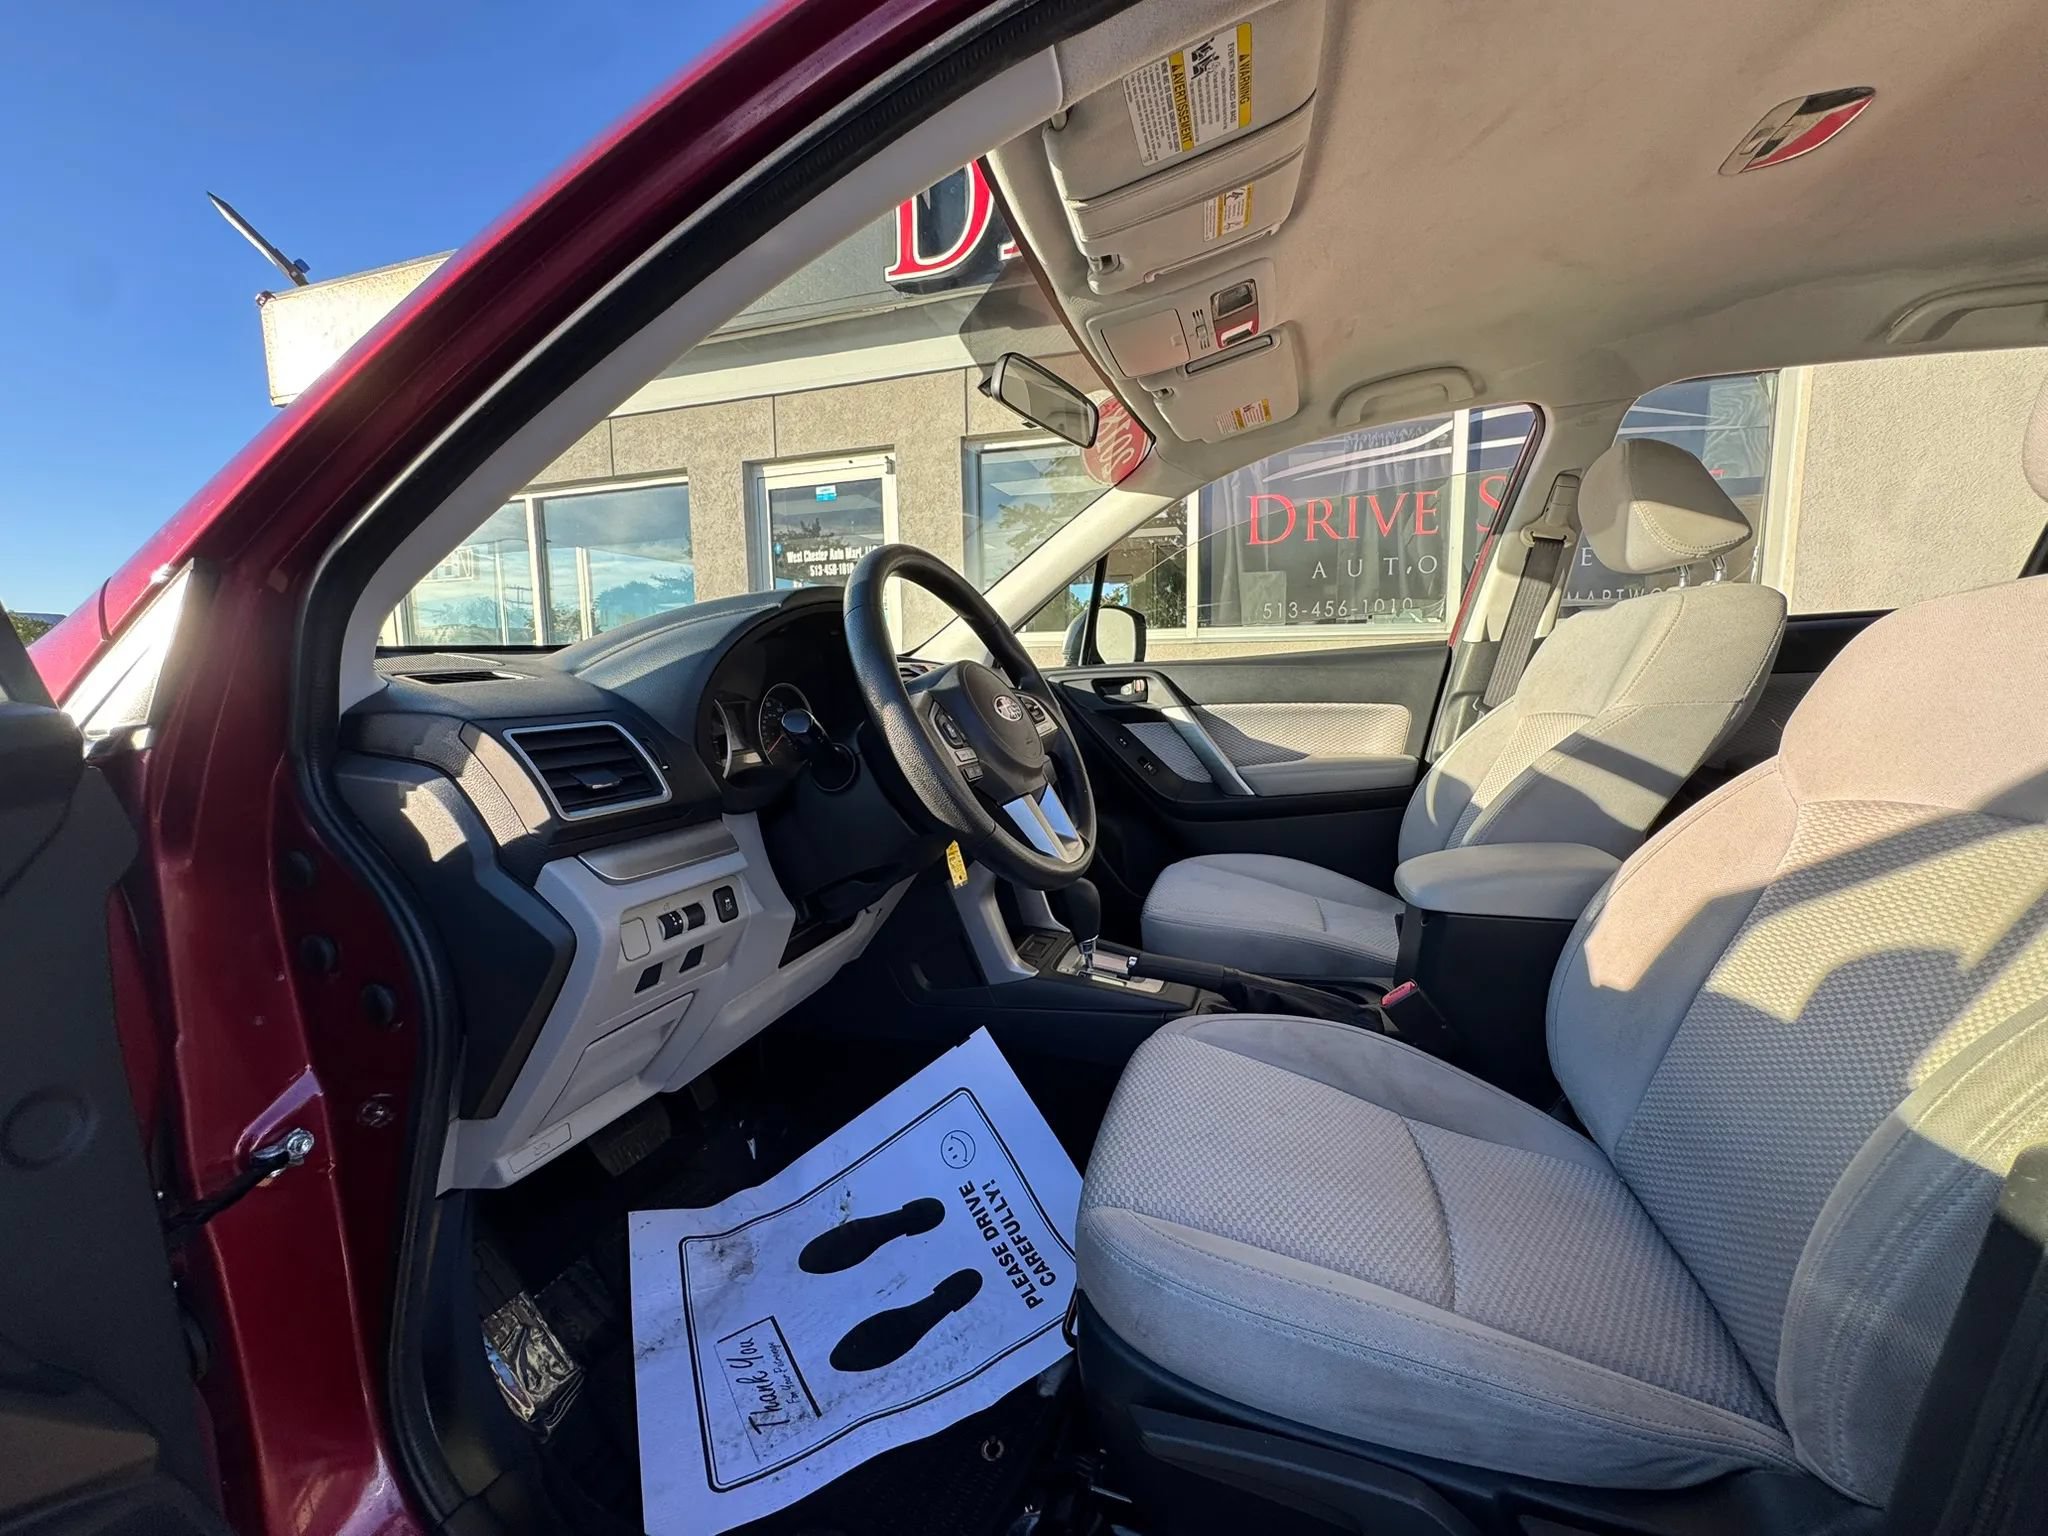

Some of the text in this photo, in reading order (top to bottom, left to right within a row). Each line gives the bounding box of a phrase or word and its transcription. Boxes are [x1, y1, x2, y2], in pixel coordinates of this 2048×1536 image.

[1172, 71, 1192, 144] AVERTISSEMENT
[1239, 64, 1251, 105] WARNING
[884, 160, 1021, 281] D
[1247, 475, 1508, 546] DRIVE S
[786, 551, 803, 563] West
[804, 549, 828, 562] Chester
[829, 548, 844, 560] Auto
[1311, 554, 1438, 579] AUTO
[1263, 597, 1414, 619] 513-456-1010
[958, 1180, 1044, 1309] PLEASE DRIVE
[981, 1179, 1056, 1287] CAREFULLY!
[726, 1337, 790, 1435] Thank You
